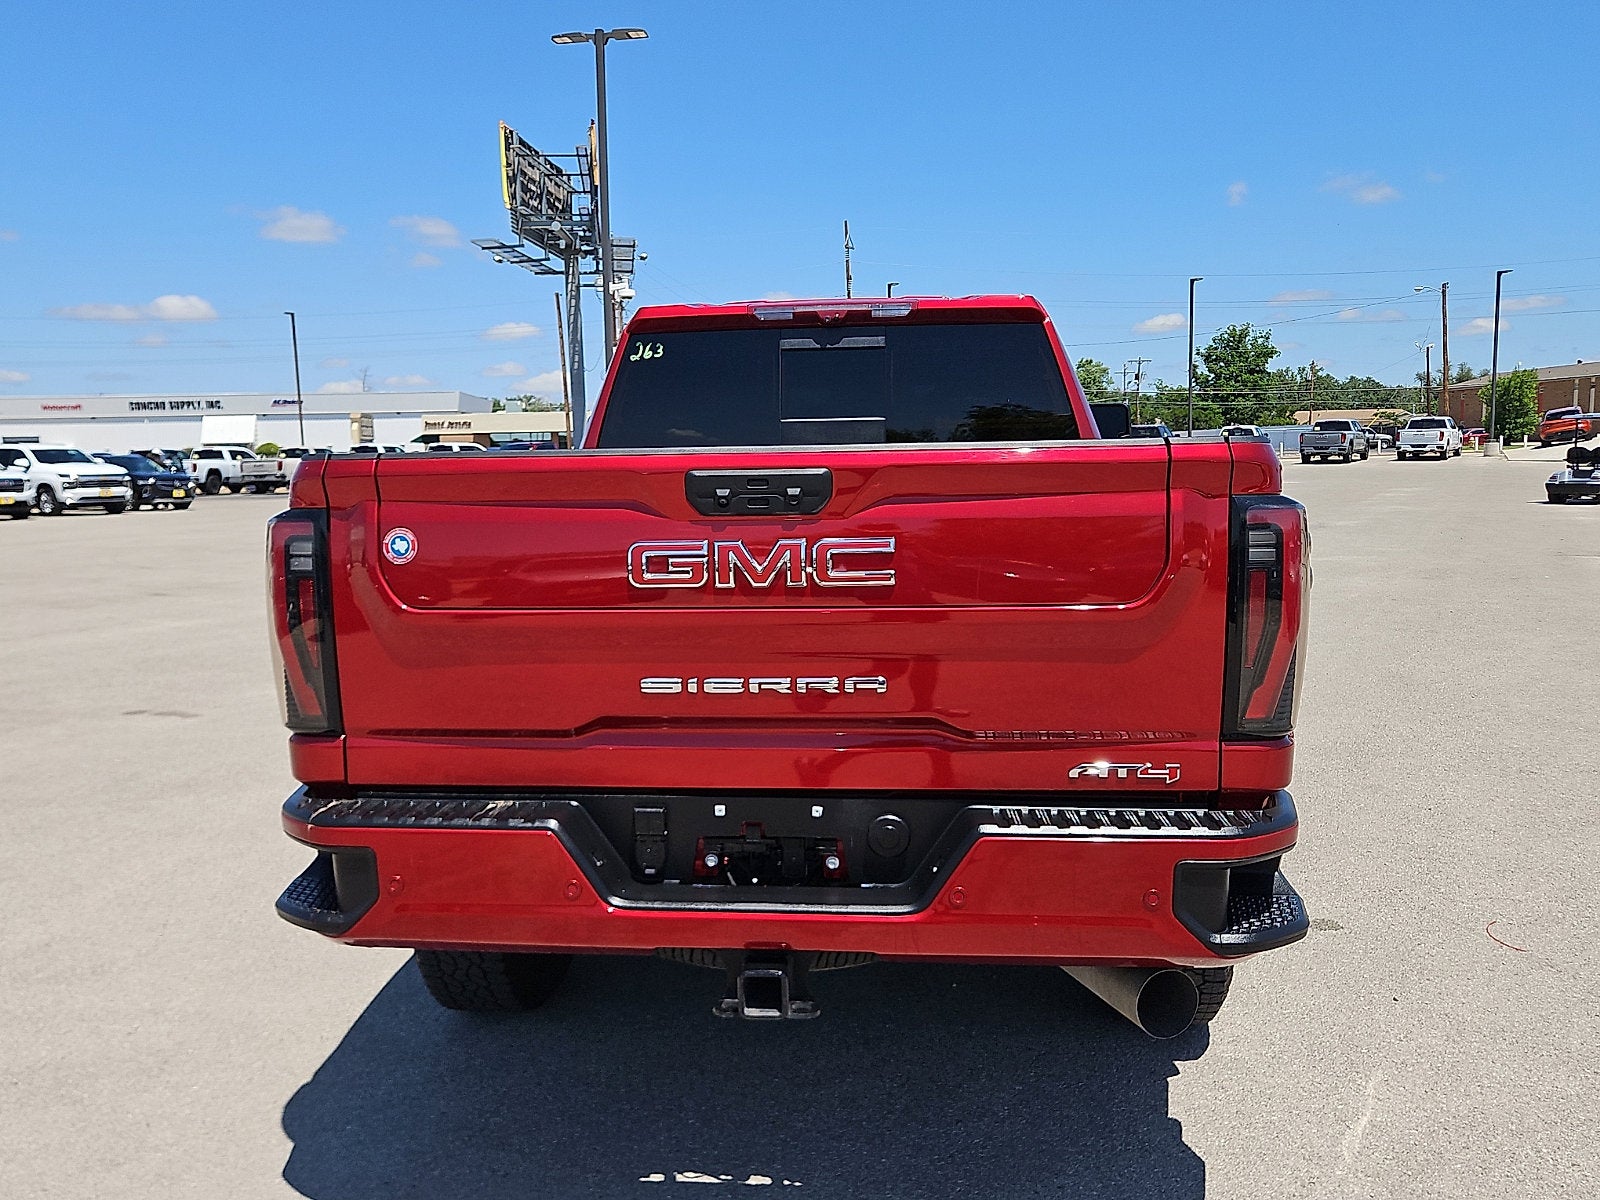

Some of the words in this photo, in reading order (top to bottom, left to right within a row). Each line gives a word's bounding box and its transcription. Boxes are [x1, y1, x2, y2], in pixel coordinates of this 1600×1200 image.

[630, 342, 664, 361] 263
[627, 537, 896, 589] GMC
[640, 676, 887, 694] SIERRA
[1068, 762, 1181, 784] AT4
